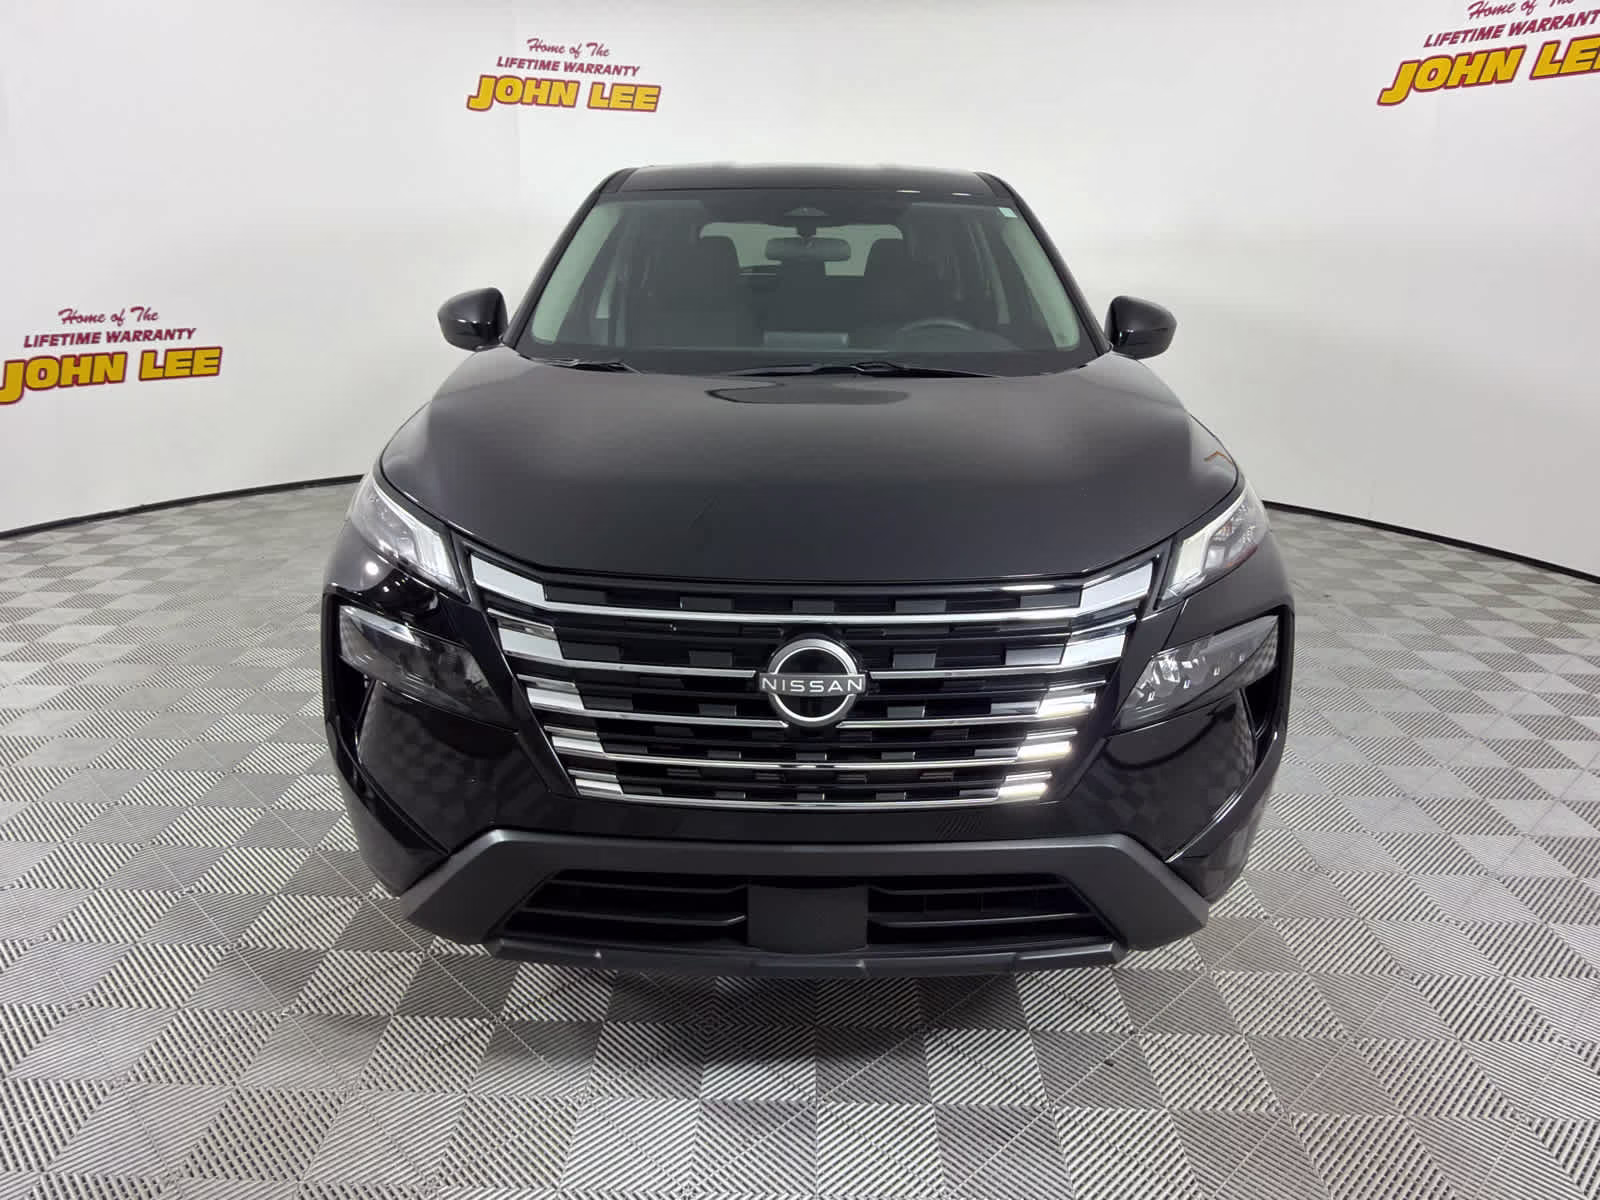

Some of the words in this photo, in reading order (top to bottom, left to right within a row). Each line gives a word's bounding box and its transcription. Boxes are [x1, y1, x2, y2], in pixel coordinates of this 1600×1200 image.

[1467, 1, 1516, 20] Home
[1424, 24, 1505, 48] LIFETIME
[526, 38, 565, 54] Home
[569, 43, 582, 58] of
[586, 42, 610, 57] The
[496, 56, 560, 72] LIFETIME
[564, 61, 640, 77] WARRANTY
[1377, 45, 1527, 106] JOHN
[1529, 34, 1600, 80] LE
[467, 75, 580, 112] JOHN
[587, 82, 661, 112] LEE
[58, 308, 106, 325] Home
[110, 310, 125, 326] of
[130, 306, 159, 322] The
[24, 331, 102, 348] LIFETIME
[106, 328, 197, 344] WARRANTY
[0, 352, 128, 405] JOHN
[139, 346, 222, 381] LEE
[761, 678, 863, 693] NISSAN
